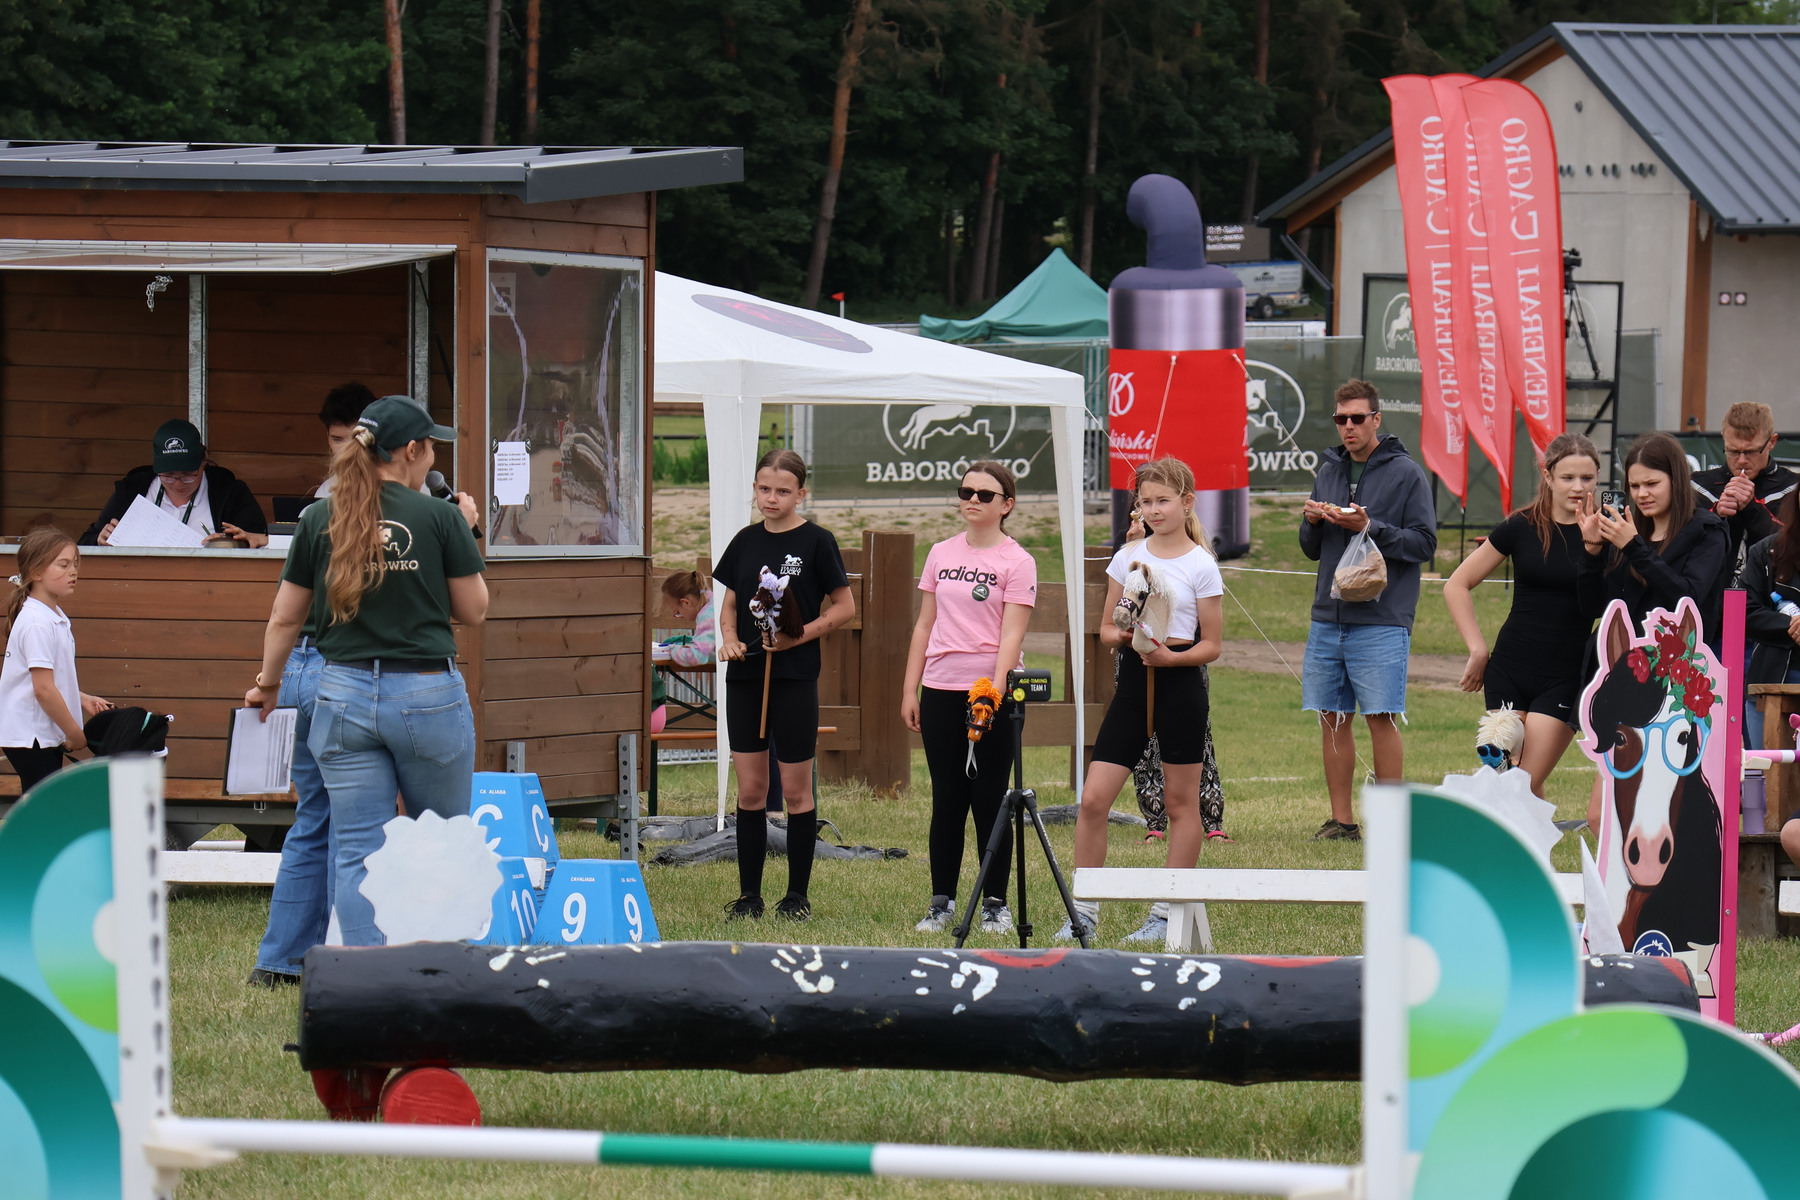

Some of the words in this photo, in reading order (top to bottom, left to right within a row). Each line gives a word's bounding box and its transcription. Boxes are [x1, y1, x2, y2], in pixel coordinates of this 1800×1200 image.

[866, 455, 1031, 483] BABORÓO
[938, 565, 998, 586] adidas
[1030, 684, 1043, 692] TEAM
[531, 804, 549, 853] C
[510, 888, 538, 939] 10
[561, 892, 587, 943] 9
[623, 893, 643, 943] 9
